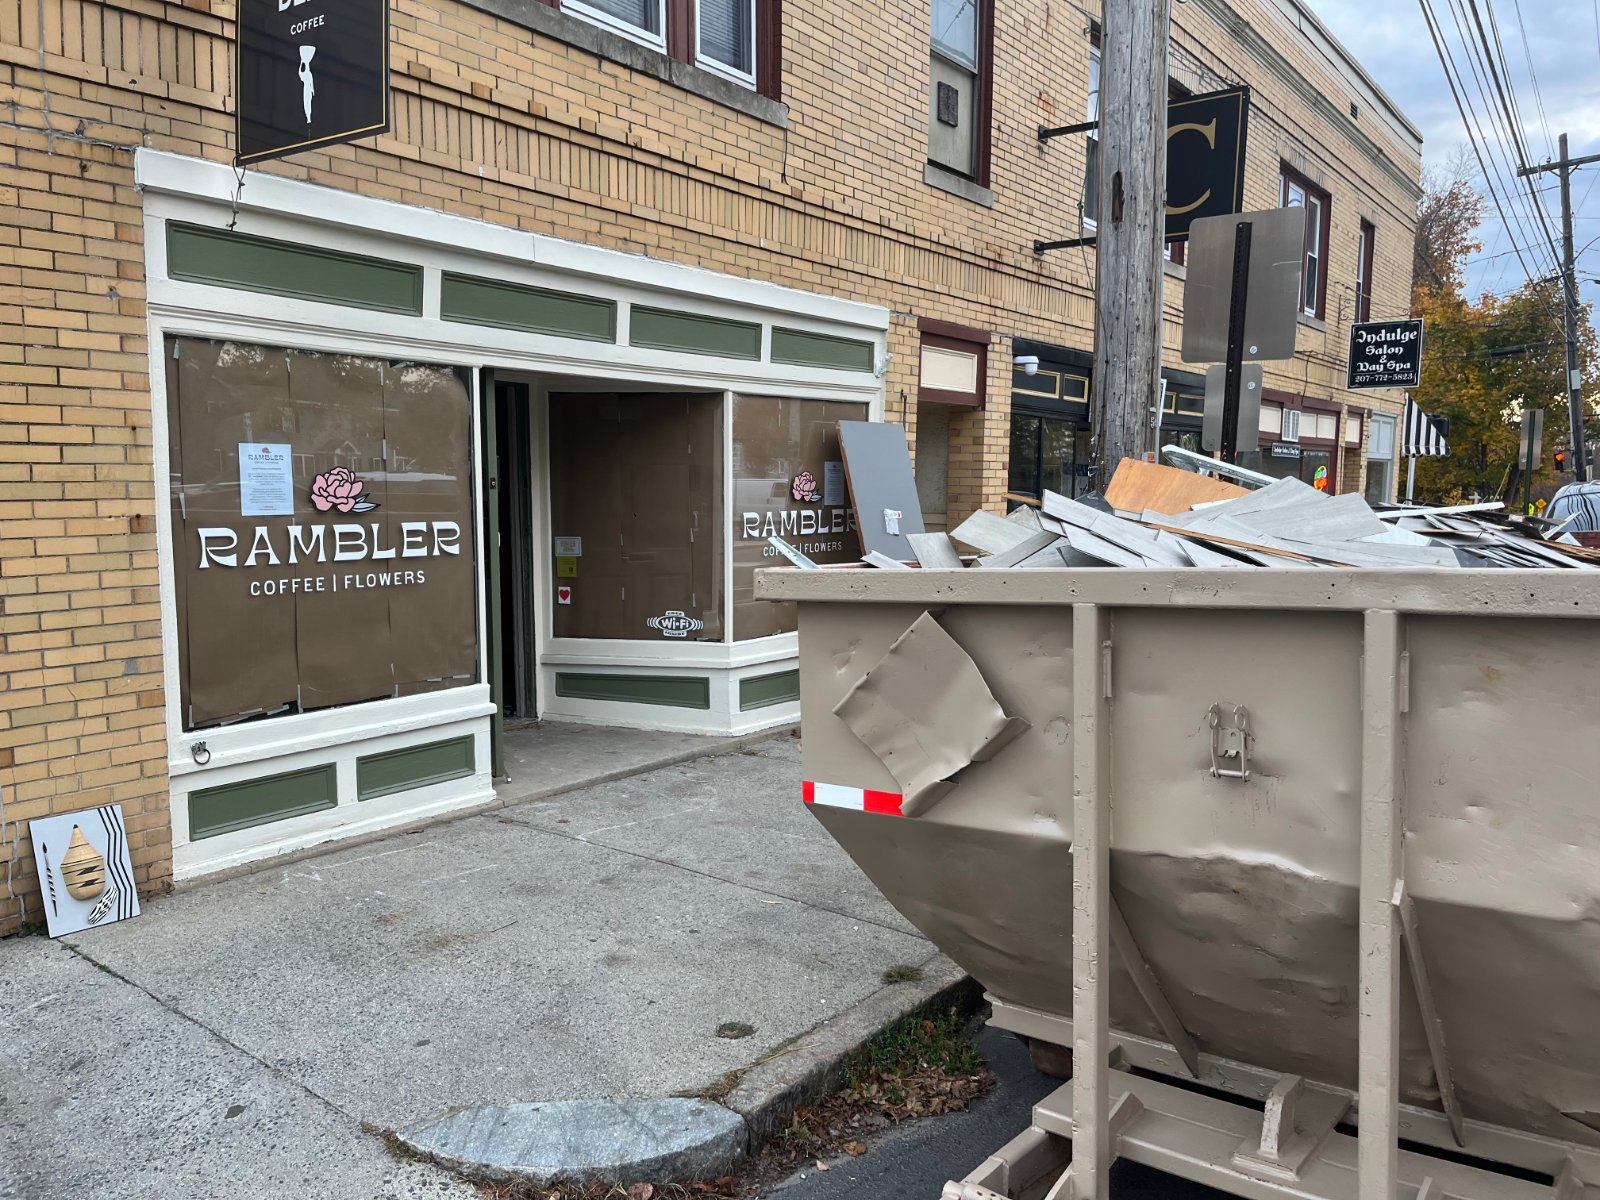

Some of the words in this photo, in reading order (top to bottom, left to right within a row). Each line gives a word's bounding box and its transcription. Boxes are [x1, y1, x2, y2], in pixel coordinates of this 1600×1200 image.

[290, 14, 325, 36] COFFEE
[1356, 328, 1418, 344] Indulge
[1365, 344, 1404, 355] Salon
[1379, 355, 1388, 363] &
[1357, 362, 1384, 372] Day
[1386, 361, 1411, 372] Spa
[1355, 373, 1413, 383] 207-772-5823
[742, 508, 857, 538] RAMBLER
[197, 521, 461, 569] RAMBLER
[804, 541, 843, 553] FLOWERS
[250, 576, 325, 597] COFFEE
[344, 570, 426, 590] FLOWERS
